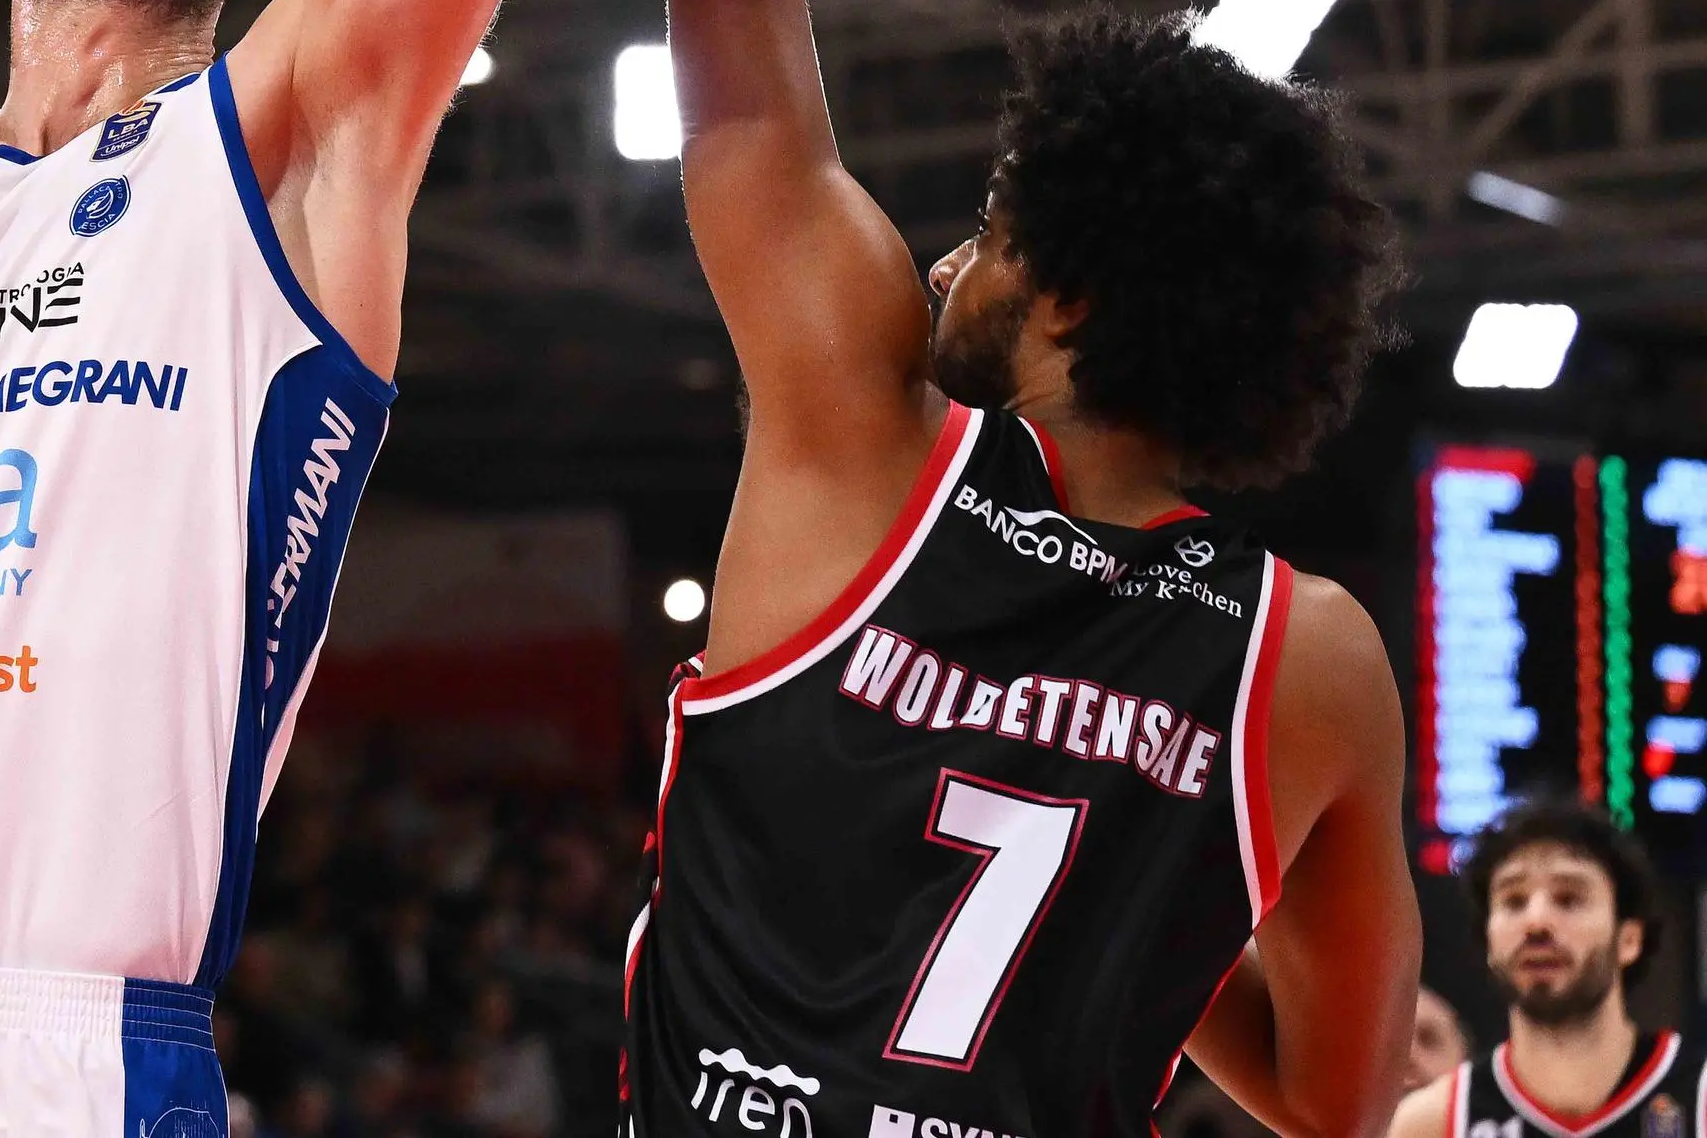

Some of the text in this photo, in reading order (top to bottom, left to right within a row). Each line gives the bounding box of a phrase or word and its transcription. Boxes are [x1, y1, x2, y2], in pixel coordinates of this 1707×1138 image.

[107, 118, 149, 140] LBA
[954, 484, 1129, 585] BANCO BPM
[838, 623, 1223, 799] WOLDETENSAE
[882, 766, 1091, 1073] 7
